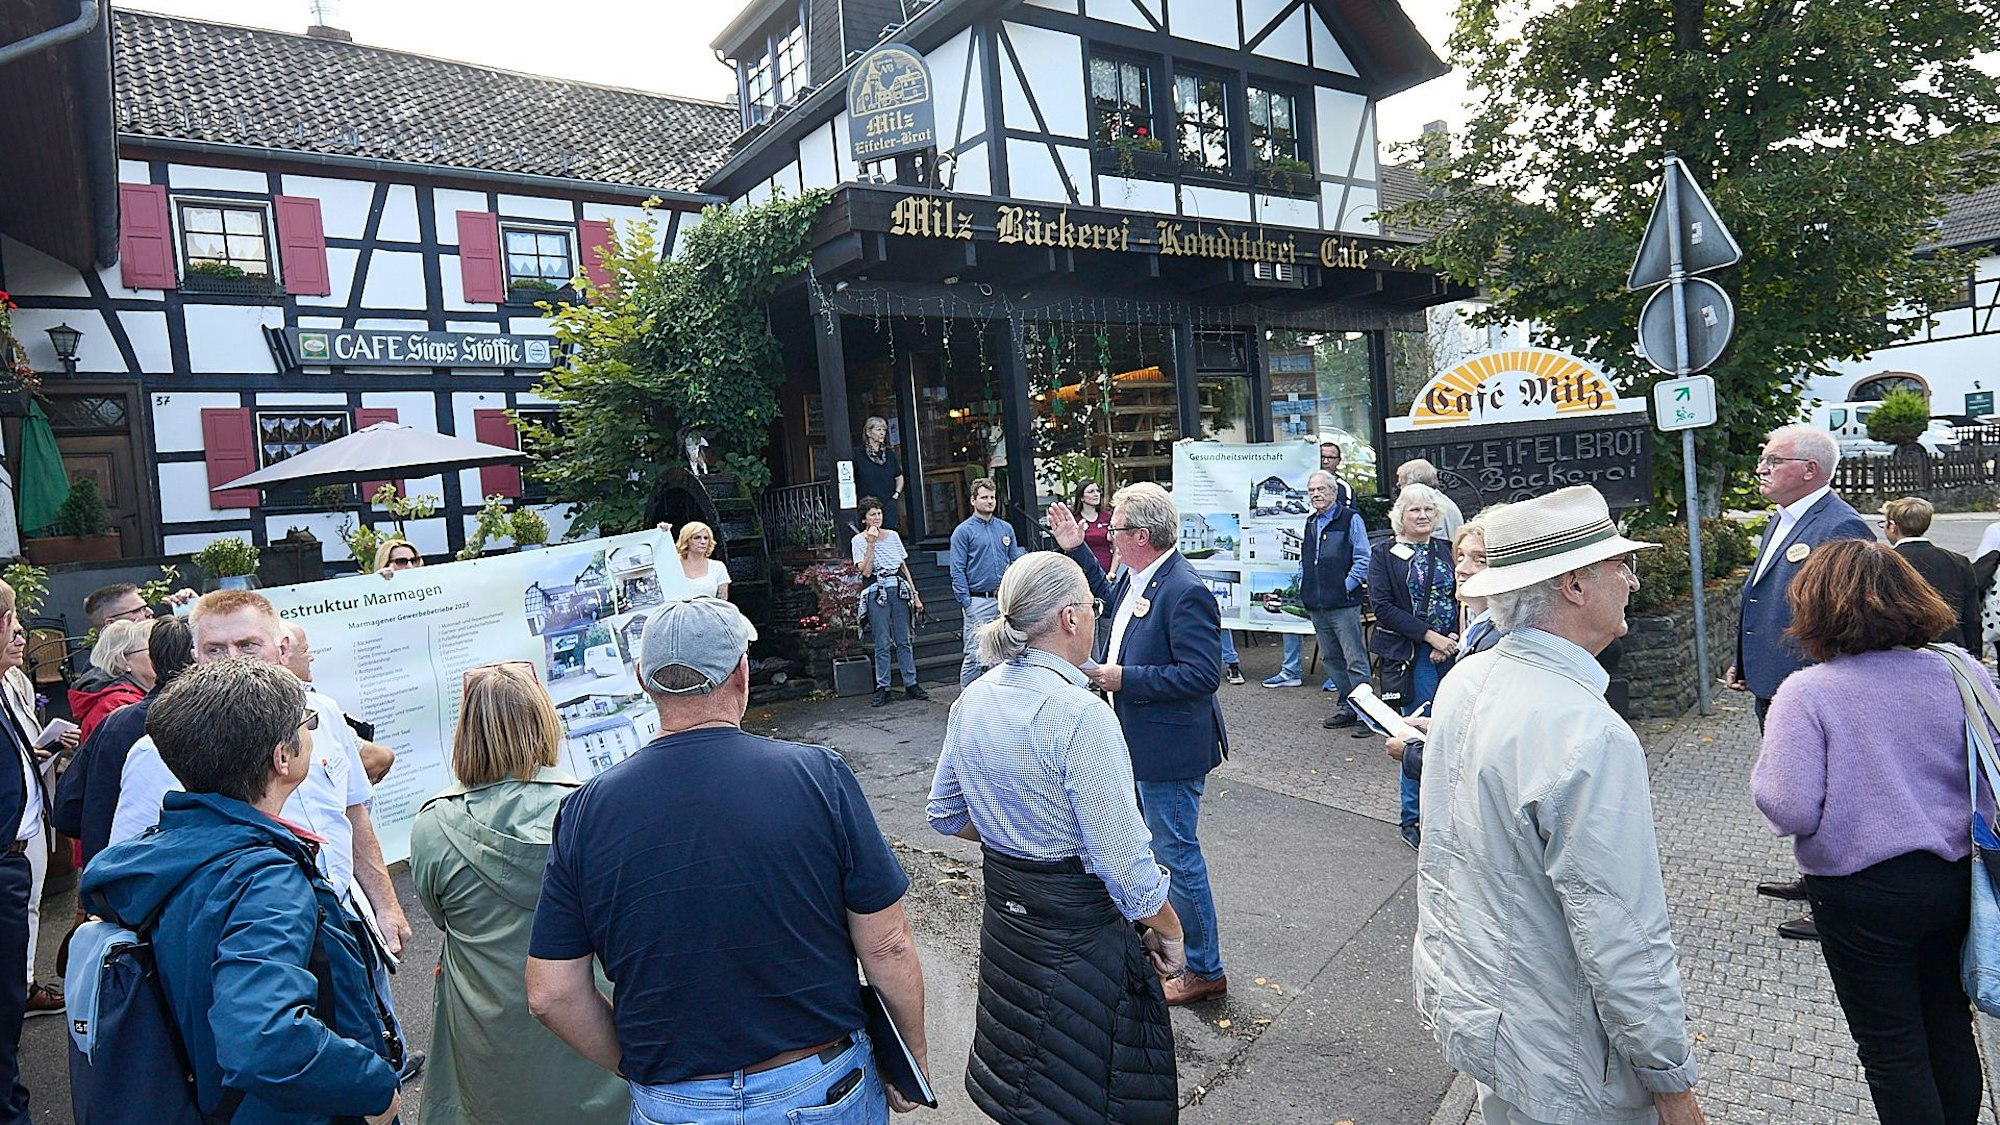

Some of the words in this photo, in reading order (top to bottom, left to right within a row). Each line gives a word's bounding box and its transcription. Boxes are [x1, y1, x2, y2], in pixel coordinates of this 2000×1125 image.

[866, 110, 915, 137] Milz
[854, 129, 932, 154] Eifeler-Brot
[889, 195, 974, 240] Milz
[996, 204, 1130, 251] Bäckerei
[334, 333, 405, 361] CAFE
[156, 396, 171, 405] 37
[1425, 381, 1504, 419] Café
[1519, 372, 1603, 410] Milz
[1189, 453, 1283, 462] Gesundheitswirtschaft
[280, 598, 359, 620] estruktur
[363, 585, 442, 607] Marmagen
[348, 615, 396, 630] Marmagener
[397, 605, 453, 621] Gewerbebetriebe
[454, 601, 470, 611] 2025
